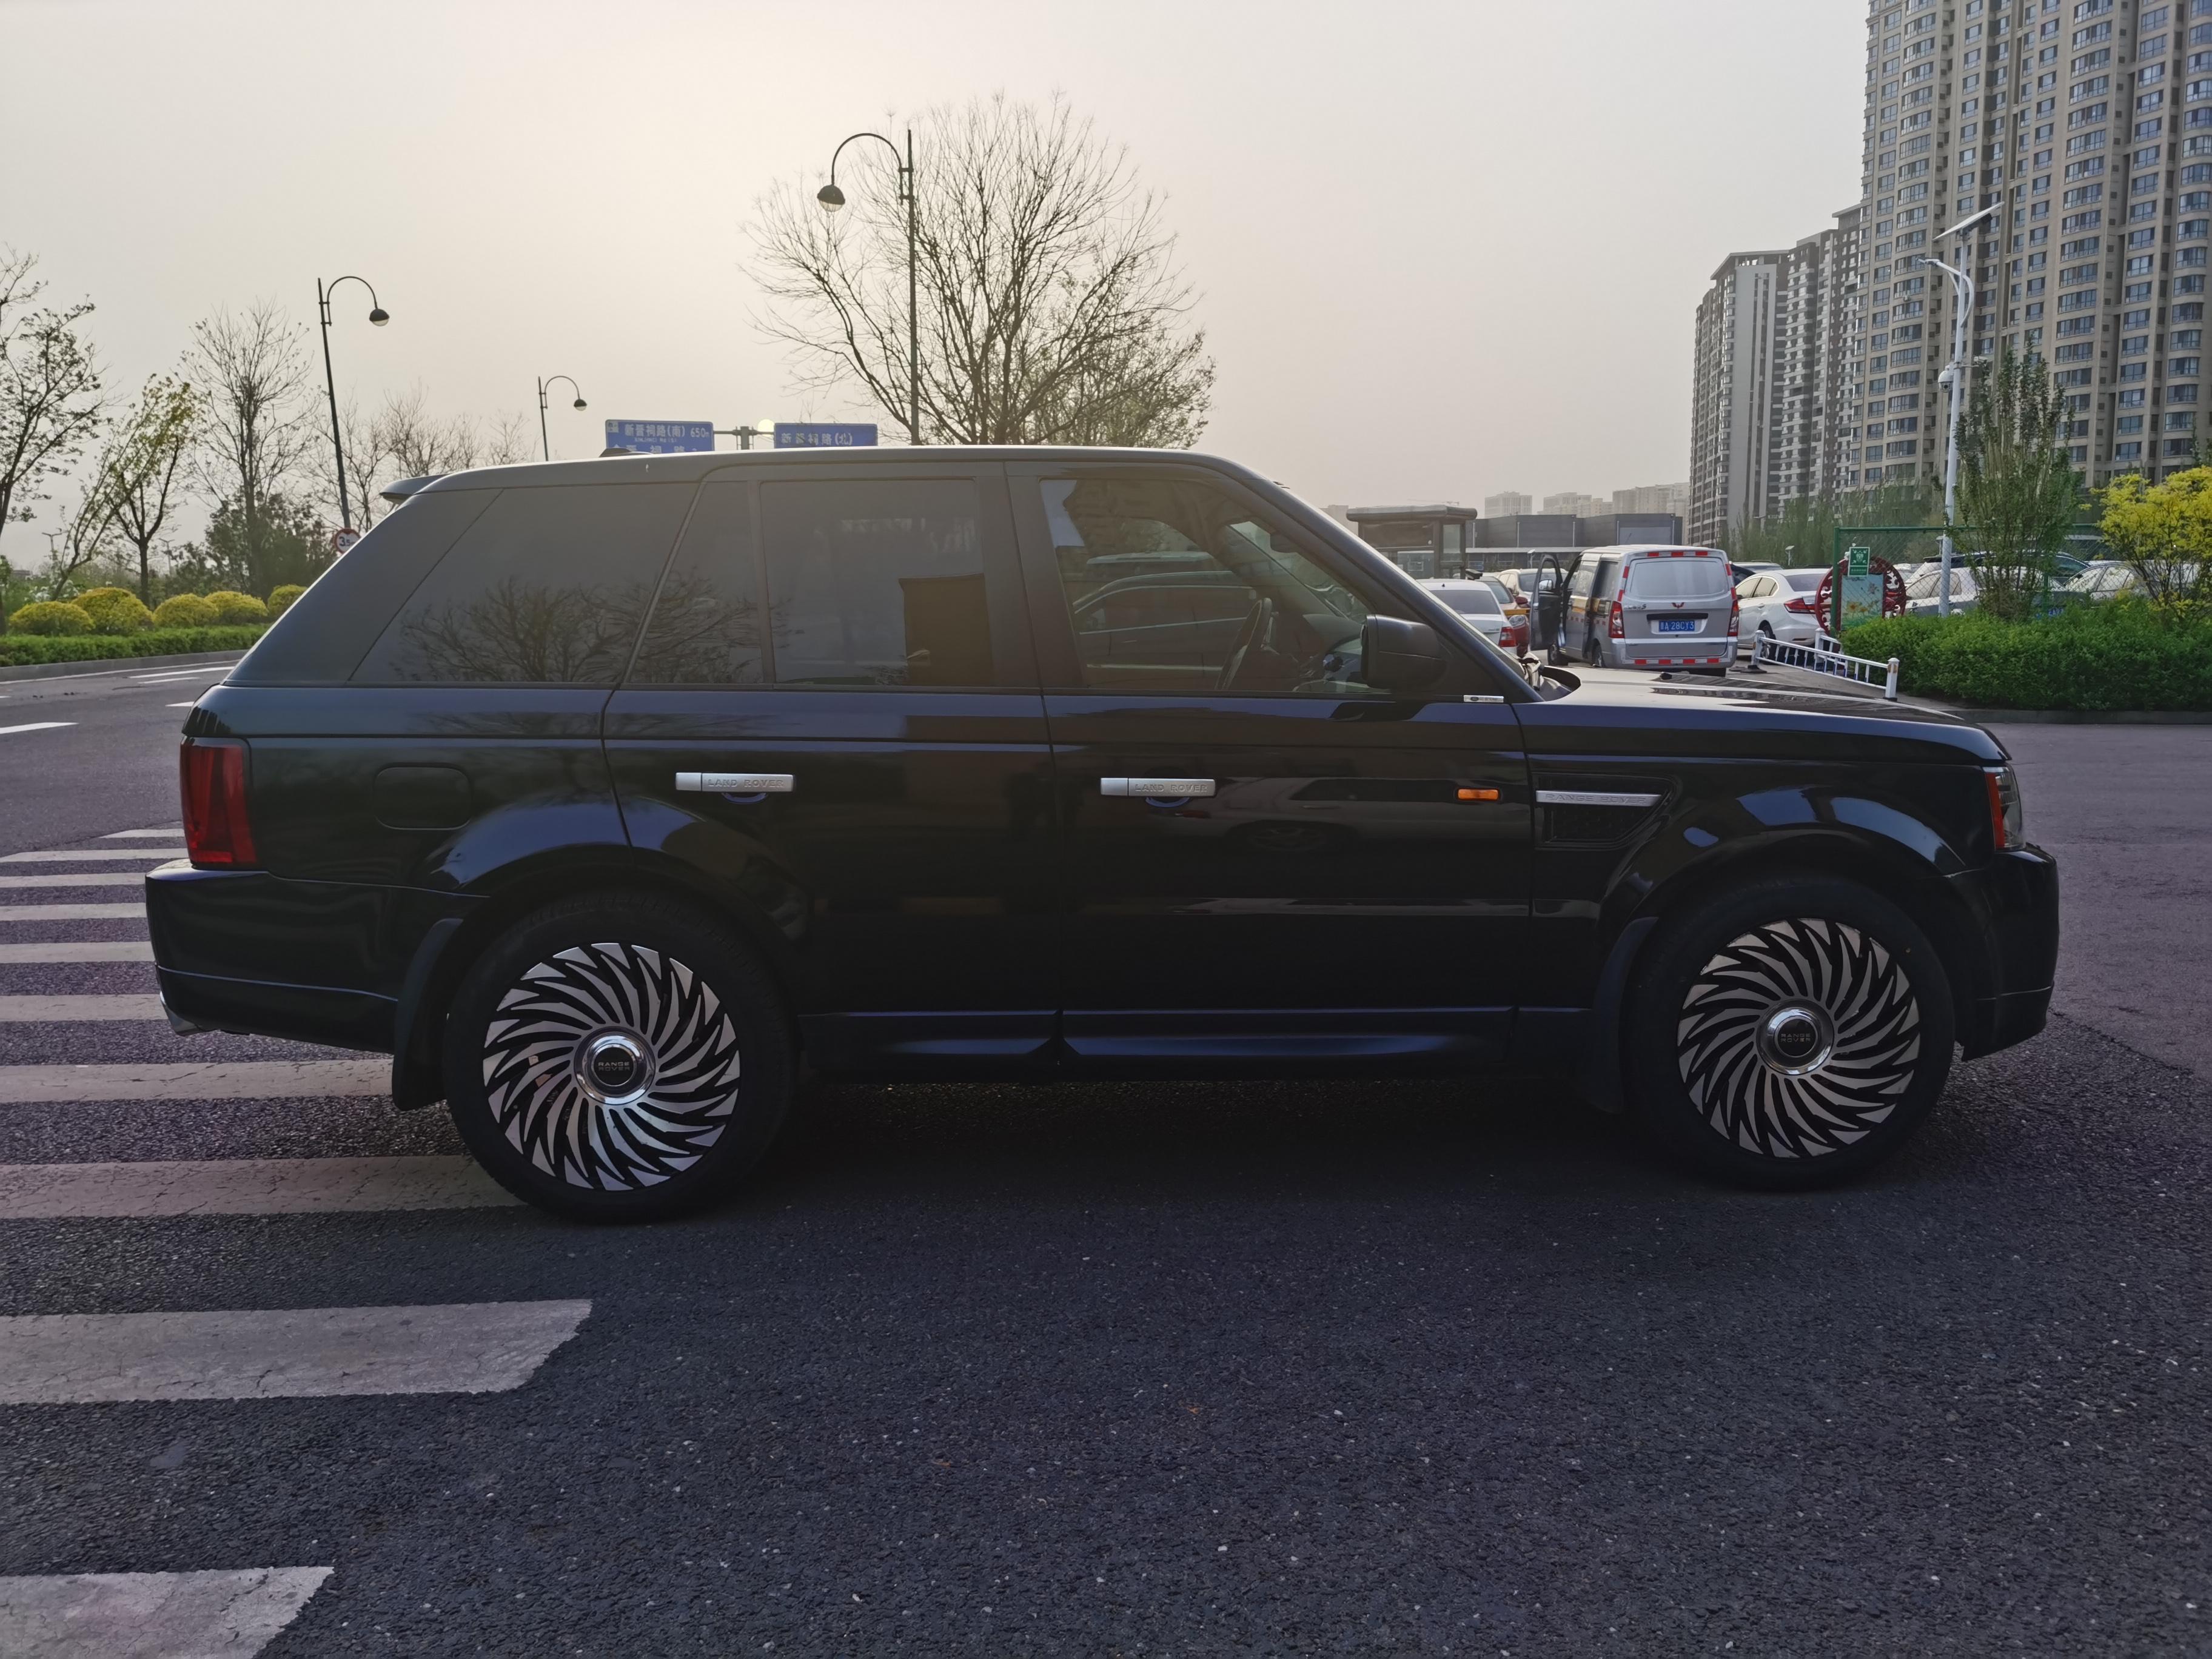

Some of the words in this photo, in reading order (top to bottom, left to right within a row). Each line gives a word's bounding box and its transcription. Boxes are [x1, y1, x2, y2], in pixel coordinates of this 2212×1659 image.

[708, 779, 737, 788] LAND
[744, 779, 784, 788] ROVER
[1134, 783, 1165, 793] LAND
[1170, 783, 1208, 793] ROVER
[1546, 793, 1595, 802] RANGE
[1600, 796, 1647, 804] ROVER
